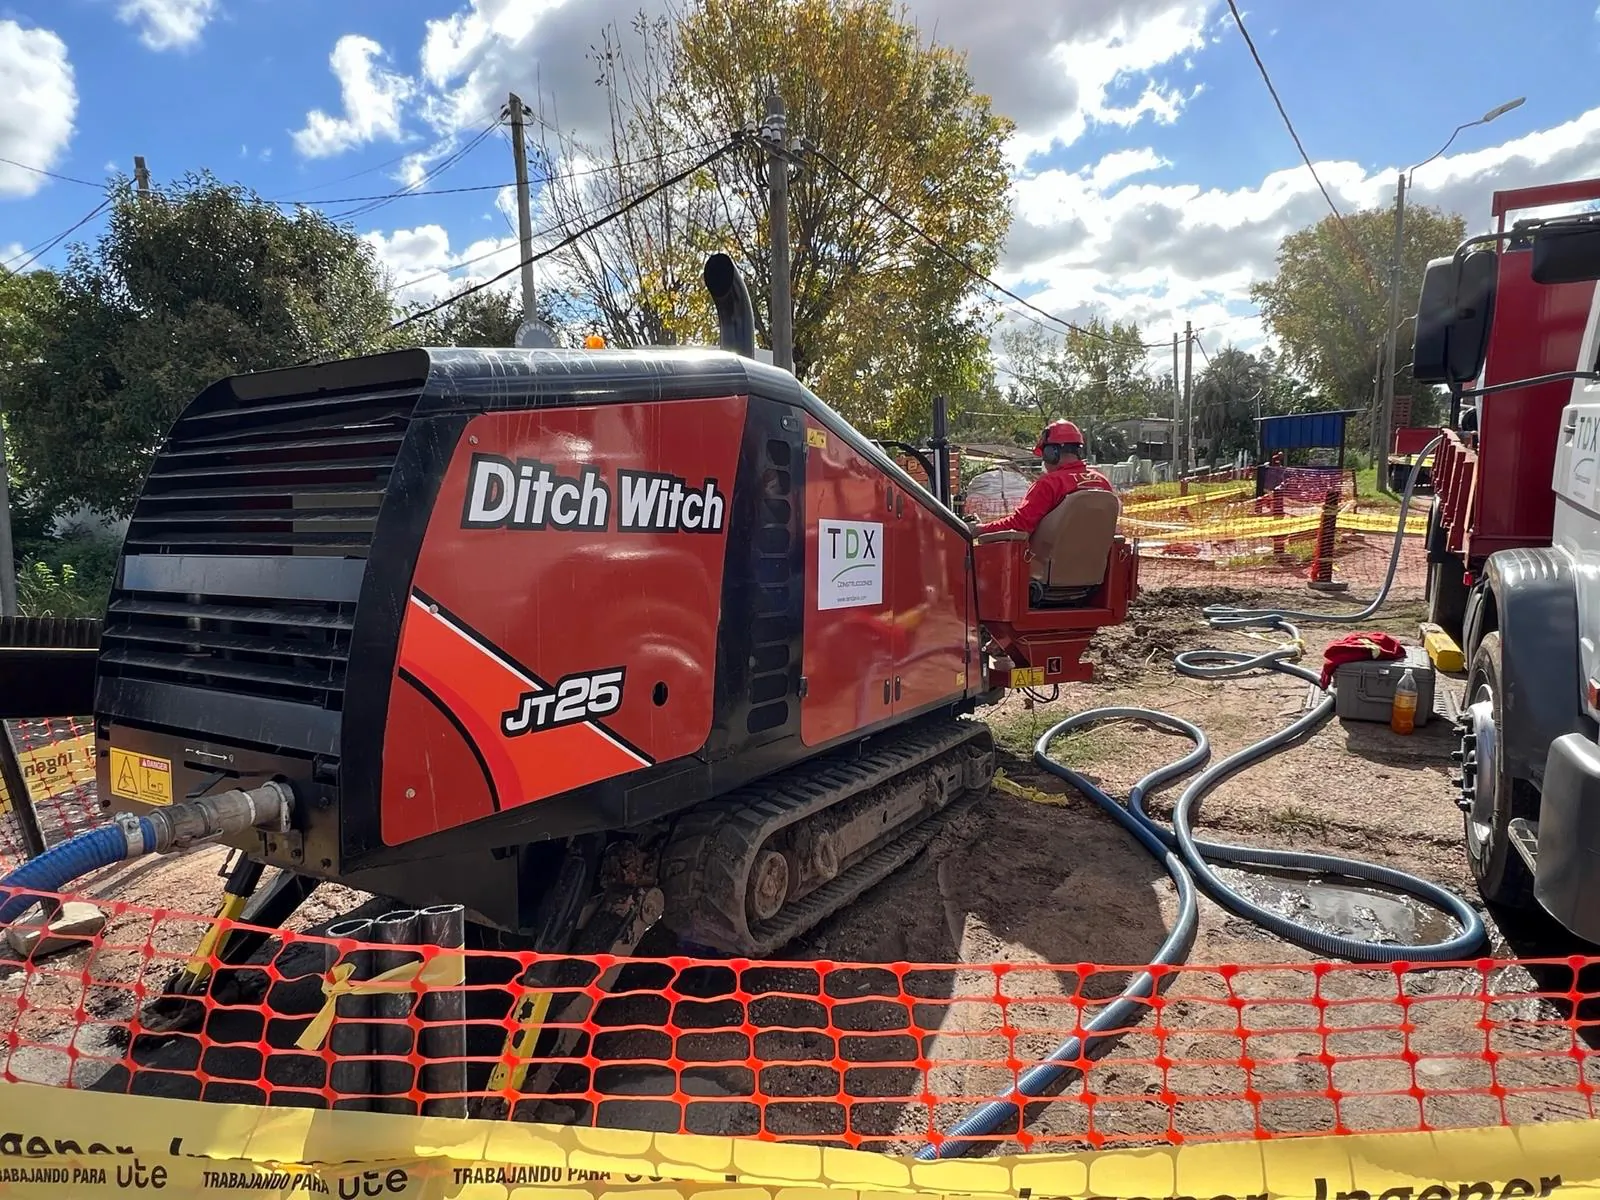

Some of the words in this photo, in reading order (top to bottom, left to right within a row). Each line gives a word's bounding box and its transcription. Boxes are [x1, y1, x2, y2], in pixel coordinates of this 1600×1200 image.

[467, 460, 608, 526] Ditch
[620, 475, 724, 529] Witch
[827, 527, 876, 560] TDX
[505, 671, 623, 731] JT25
[72, 1168, 107, 1184] PARA
[203, 1171, 291, 1190] TRABAJANDO
[291, 1174, 330, 1195] PARA
[453, 1165, 562, 1185] TRABAJANDO
